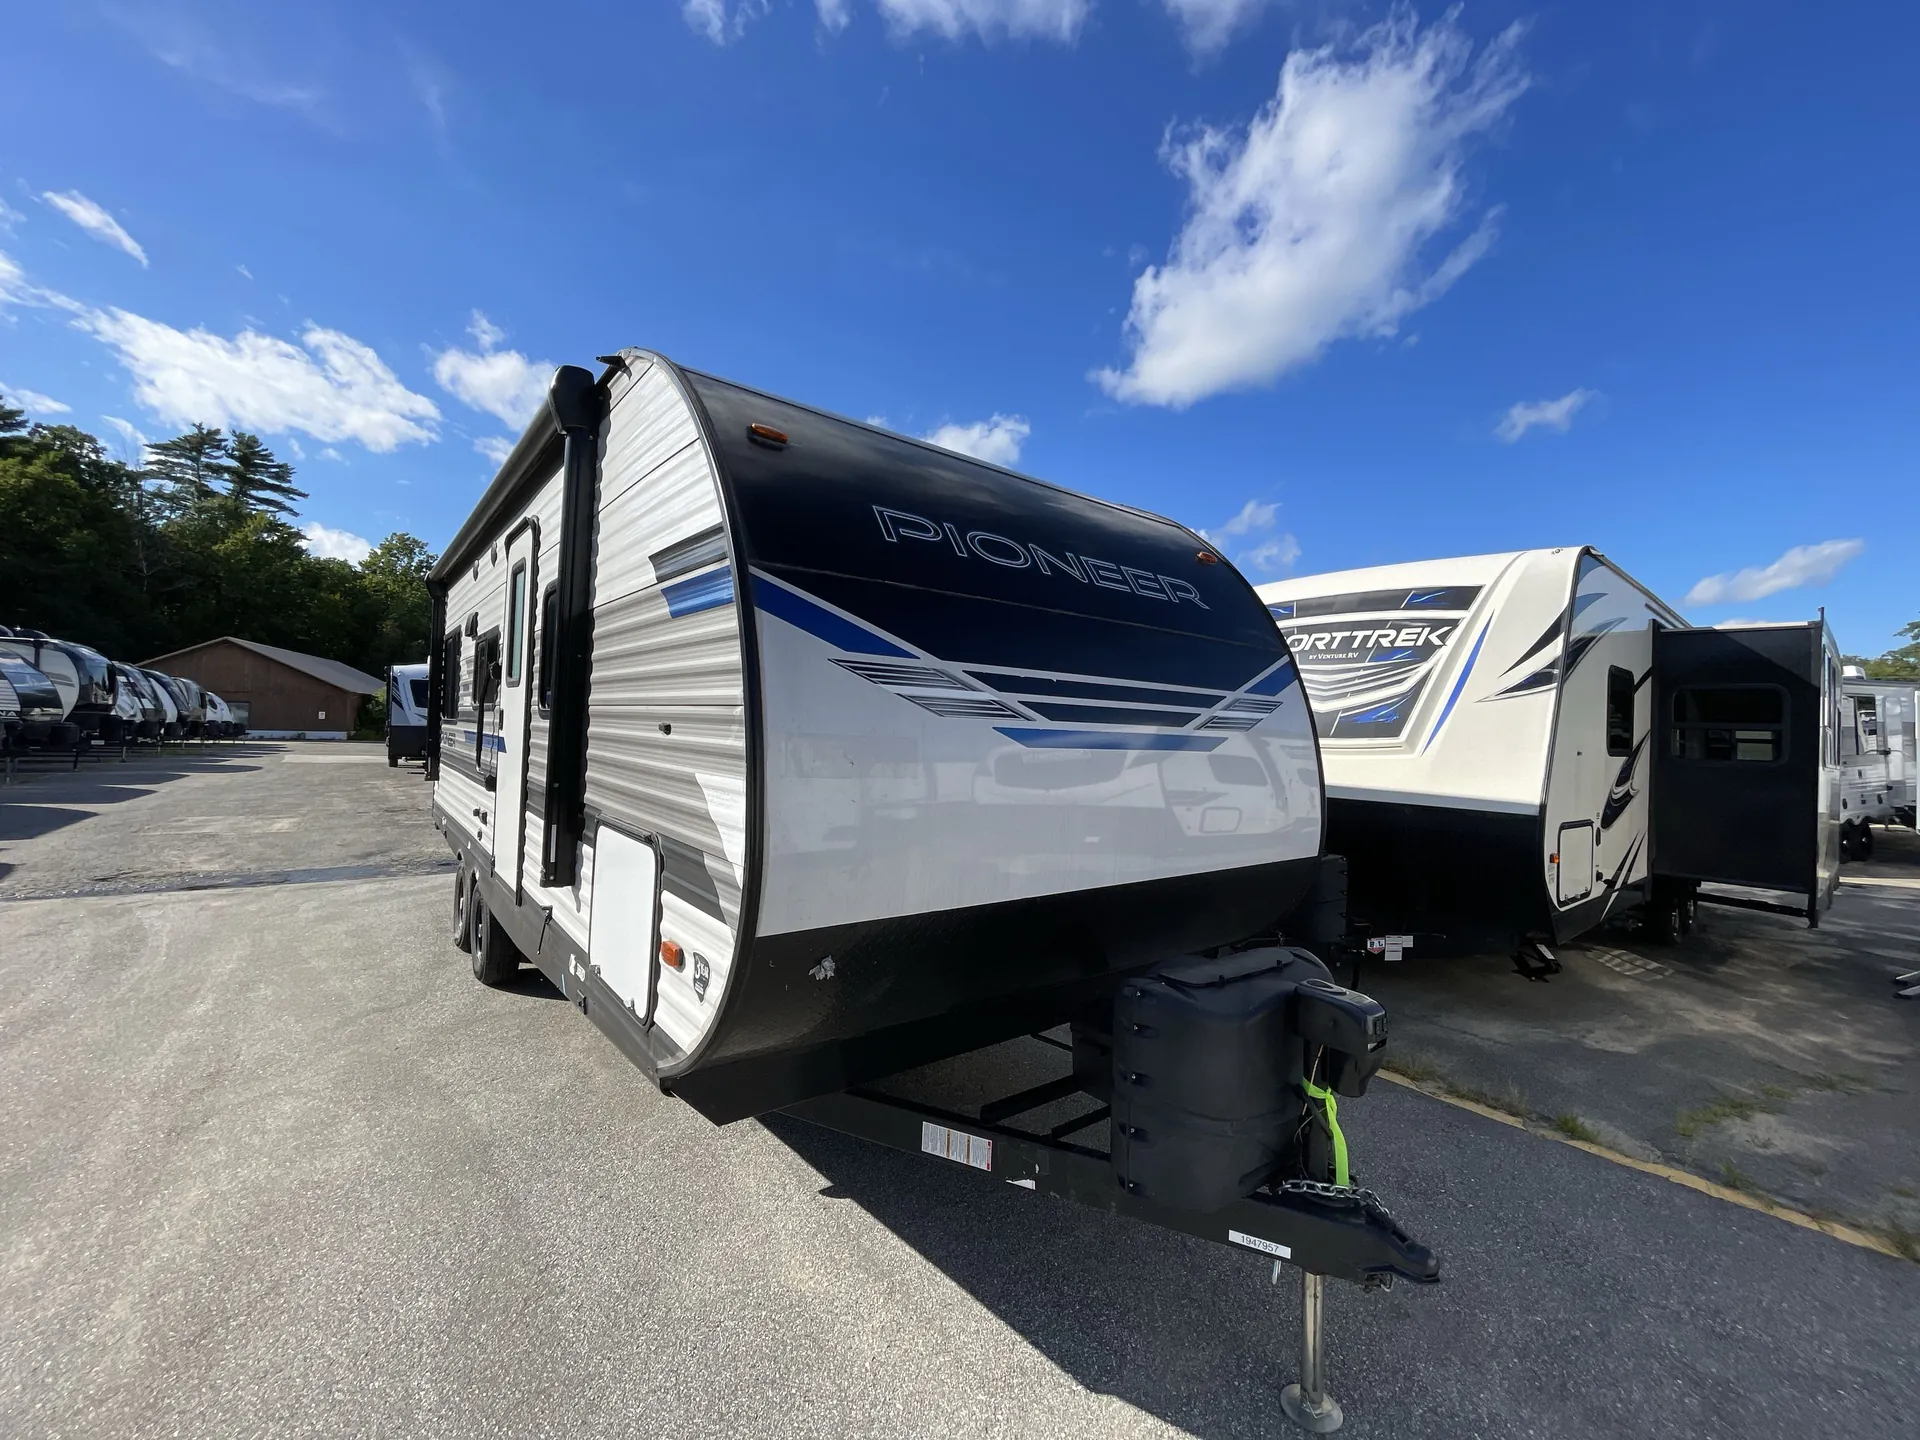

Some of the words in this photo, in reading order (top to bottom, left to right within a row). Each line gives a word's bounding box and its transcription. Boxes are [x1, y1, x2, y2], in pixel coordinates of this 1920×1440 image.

[872, 505, 1210, 609] PIONEER
[1285, 626, 1452, 652] ORTTREK
[1240, 1235, 1279, 1253] 1947957
